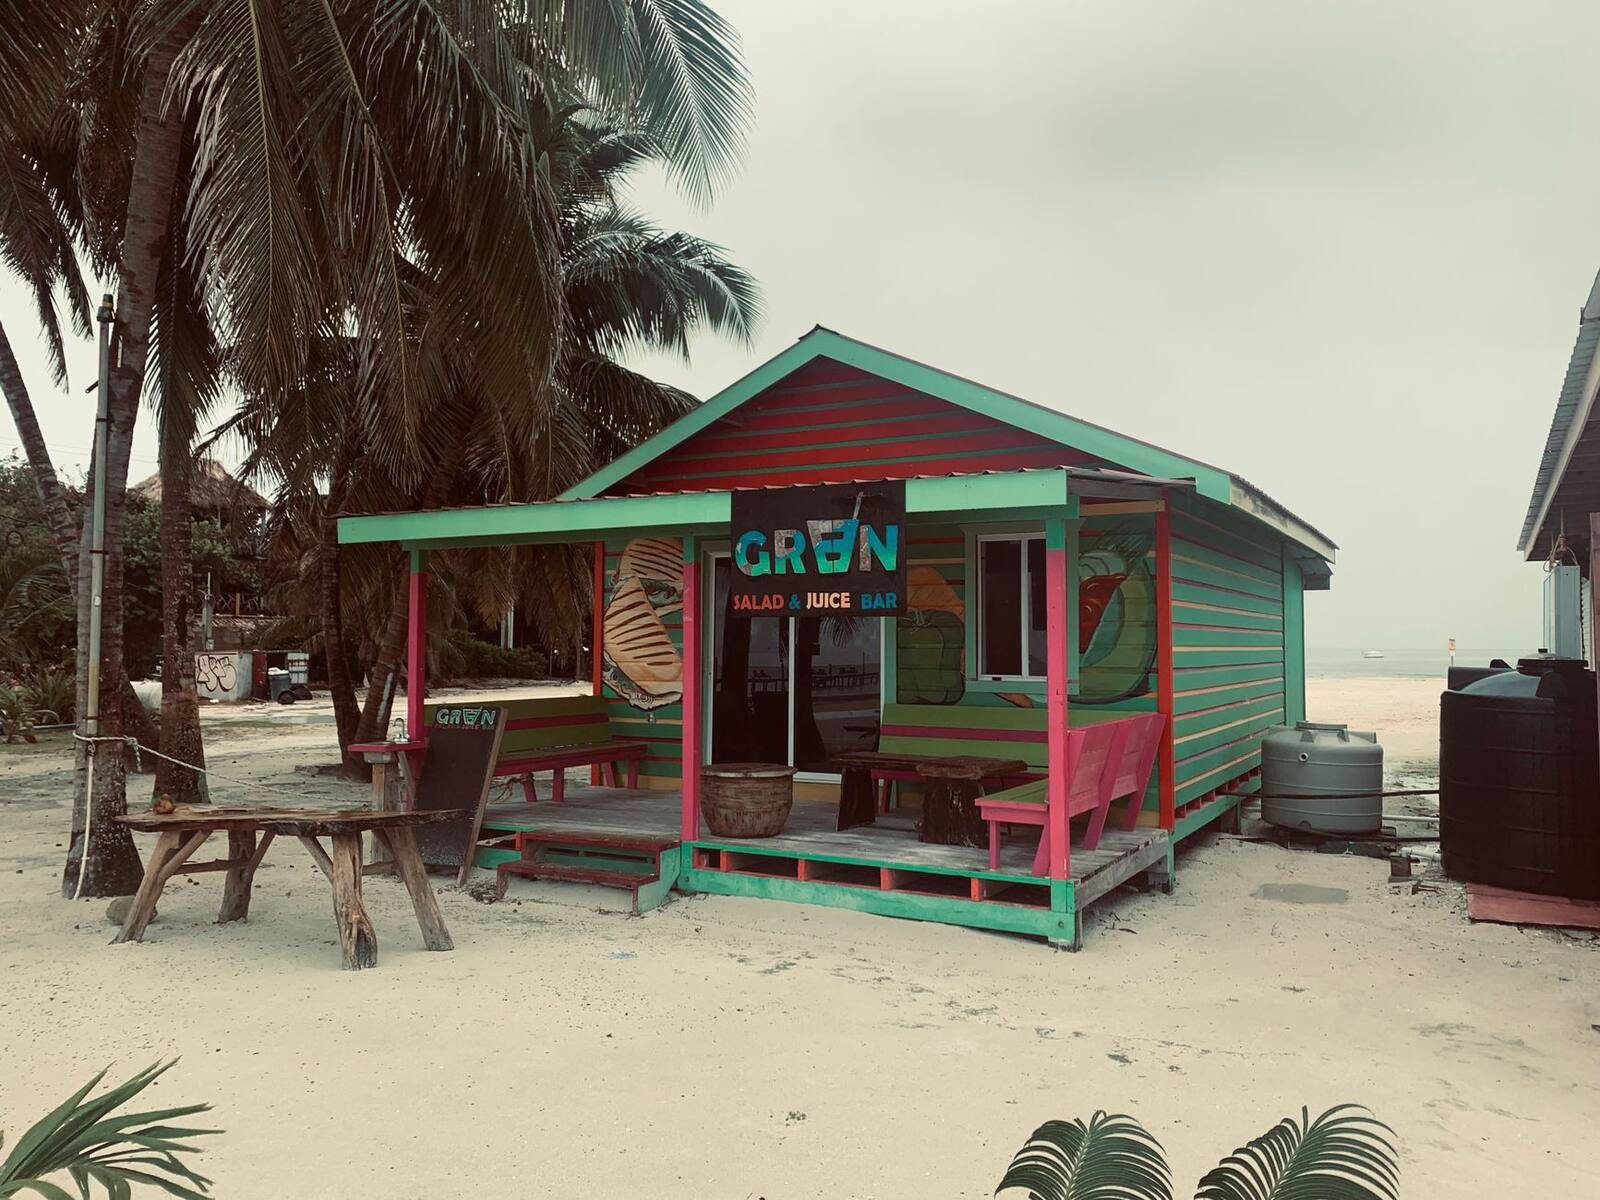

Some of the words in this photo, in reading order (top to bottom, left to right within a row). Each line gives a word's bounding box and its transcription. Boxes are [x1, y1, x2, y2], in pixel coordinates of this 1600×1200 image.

[733, 594, 784, 610] SALAD
[788, 594, 801, 610] &
[806, 592, 851, 610] JUICE
[861, 592, 897, 610] BAR
